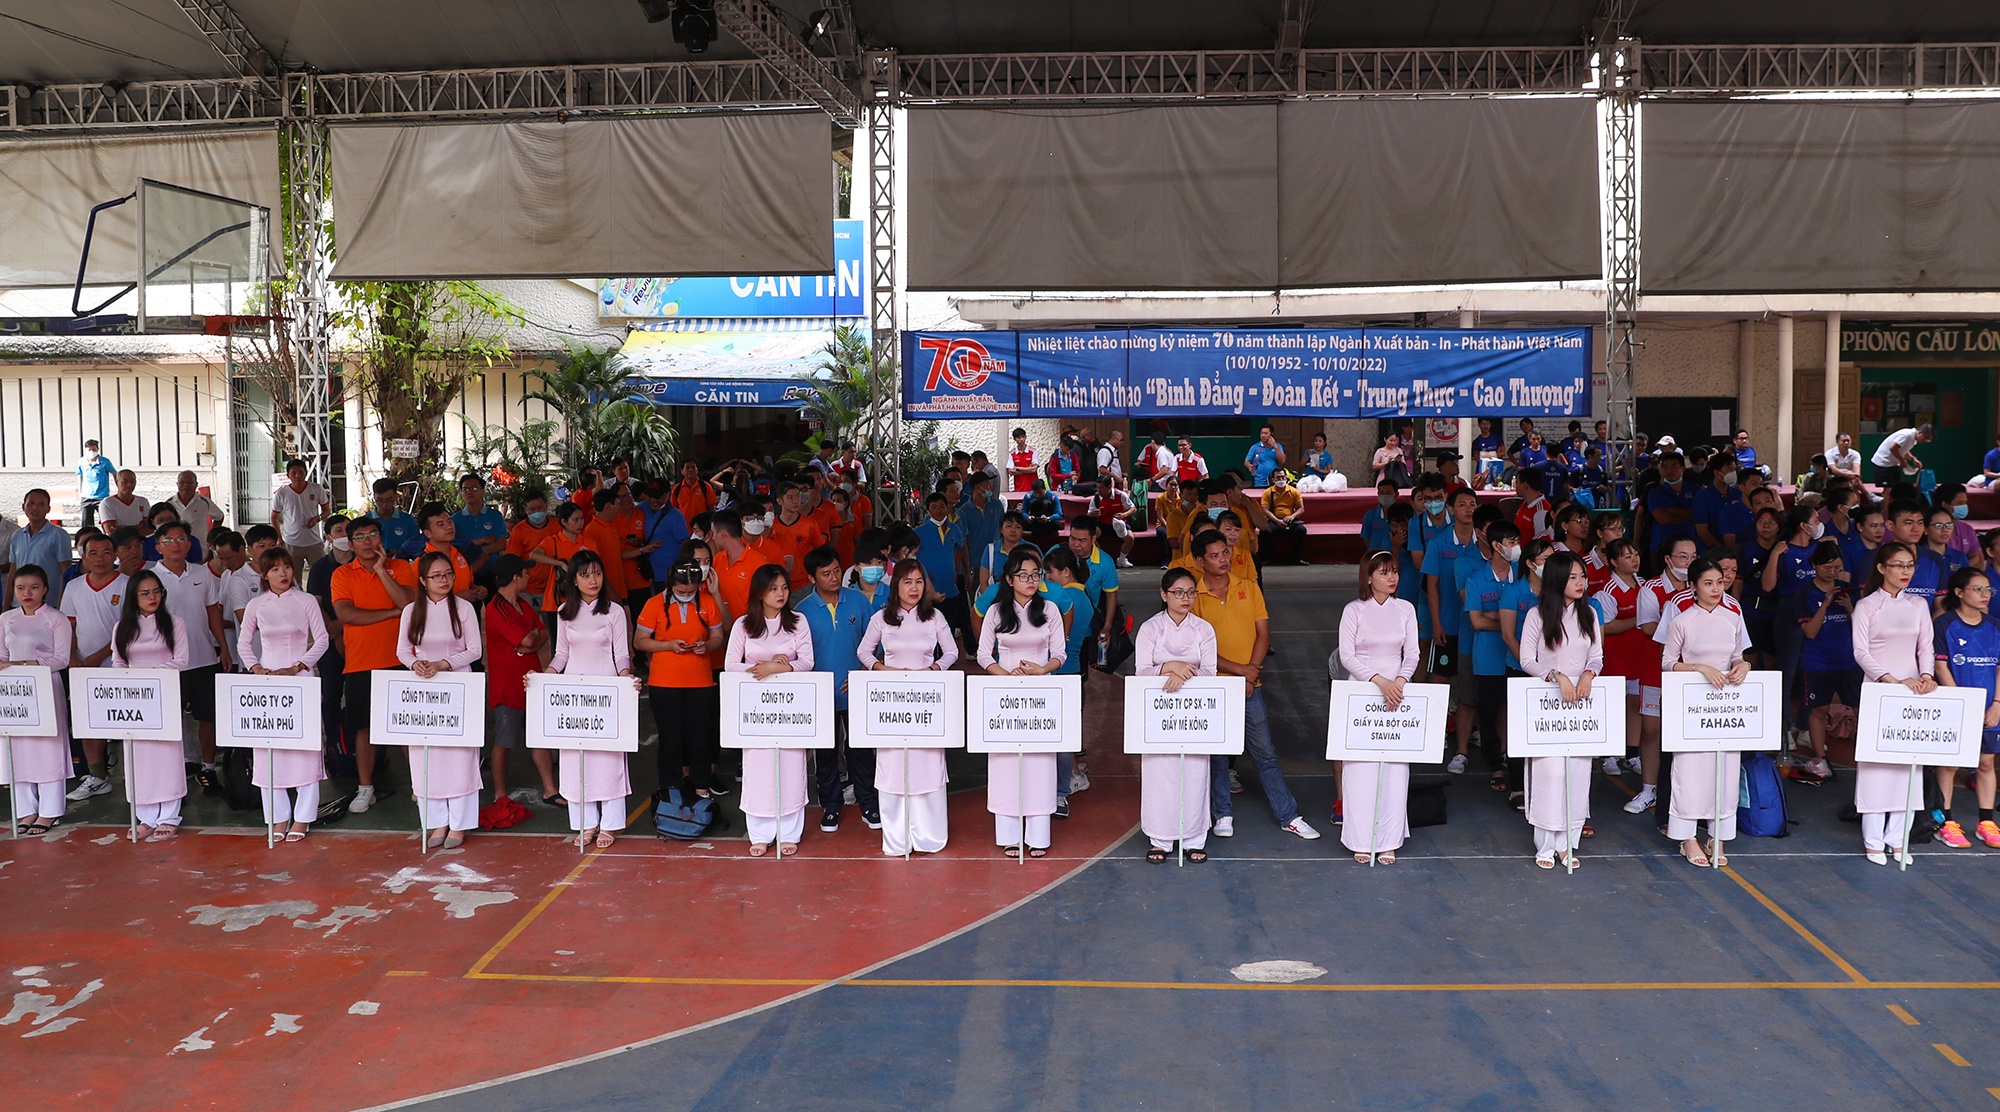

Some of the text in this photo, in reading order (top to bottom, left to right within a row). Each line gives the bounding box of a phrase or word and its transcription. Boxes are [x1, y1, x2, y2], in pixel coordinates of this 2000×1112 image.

[1028, 332, 1582, 354] Nhiệt liệt chào mừng kỷ niệm 70 năm thành lập Ngành Xuất bản In Phát hành Việt Nam
[1841, 328, 1910, 352] PHÒNG
[983, 360, 1006, 372] NĂM
[1226, 356, 1387, 373] (10/10/1952 10/10/2022)
[694, 388, 759, 403] CĂN TIN
[933, 394, 957, 403] NGÀNH
[960, 393, 977, 403] XUẤT
[1059, 375, 1090, 409] thần
[1093, 378, 1110, 416] hội
[1113, 378, 1141, 409] thao
[1199, 371, 1244, 415] Đẳng
[1262, 377, 1306, 407] Đoàn
[1311, 375, 1339, 408] Kết
[1357, 379, 1409, 415] Trung
[1413, 379, 1454, 413] Thực
[1473, 378, 1505, 408] Cao
[908, 402, 1019, 412] IN VÀ PHÁT HÀNH SÁCH VIỆT NAM
[10, 680, 22, 697] XUẤT
[23, 681, 33, 697] BẢN
[94, 684, 155, 700] CÔNG TY TNHH MTV
[401, 687, 451, 704] CÔNG TY TNHH MTV
[761, 689, 794, 704] CÔNG TY CP
[1706, 691, 1723, 700] CÔNG
[1732, 692, 1740, 700] CP
[240, 692, 294, 708] CÔNG TY CP
[550, 690, 611, 708] CÔNG TY TNHH MTV
[870, 688, 942, 706] CÔNG TY TNHH CÔNG NGHỆ IN
[1000, 695, 1046, 709] CÔNG TY TNHH
[1154, 695, 1216, 710] CÔNG TY CP SX TM
[1540, 691, 1559, 710] TỔNG
[1585, 698, 1593, 709] TY
[3, 704, 17, 718] NHÂN
[18, 704, 29, 718] DÂN
[107, 709, 144, 722] ITAXA
[743, 706, 812, 727] IN TỔNG HỢP BÌNH DƯƠNG
[1400, 704, 1411, 713] CP
[1688, 705, 1702, 714] PHÁT
[1703, 704, 1719, 713] HÀNH
[1720, 704, 1735, 713] SÁCH
[1745, 705, 1758, 713] HCM
[1902, 705, 1941, 720] CÔNG TY CP
[241, 712, 294, 731] IN TRẦN PHÚ
[392, 713, 398, 725] IN
[399, 710, 410, 725] BÁO
[411, 711, 425, 726] NHÂN
[427, 711, 438, 726] DÂN
[446, 715, 459, 727] HCM
[557, 714, 604, 734] LÊ QUANG LỘC
[879, 709, 933, 727] KHANG VIỆT
[989, 713, 1056, 730] GIẤY VI TÍNH LIÊN SƠN
[1162, 714, 1208, 731] GIẤY MÊ KÔNG
[1353, 715, 1420, 730] GIẤY VÀ BỘT GIẤY
[1535, 716, 1598, 732] VĂN HOÁ SÀI GÒN
[1700, 718, 1745, 729] FAHASA
[1371, 732, 1401, 740] STAVIAN
[1882, 726, 1957, 743] VĂN HOÁ SÁCH SÀI GÒN
